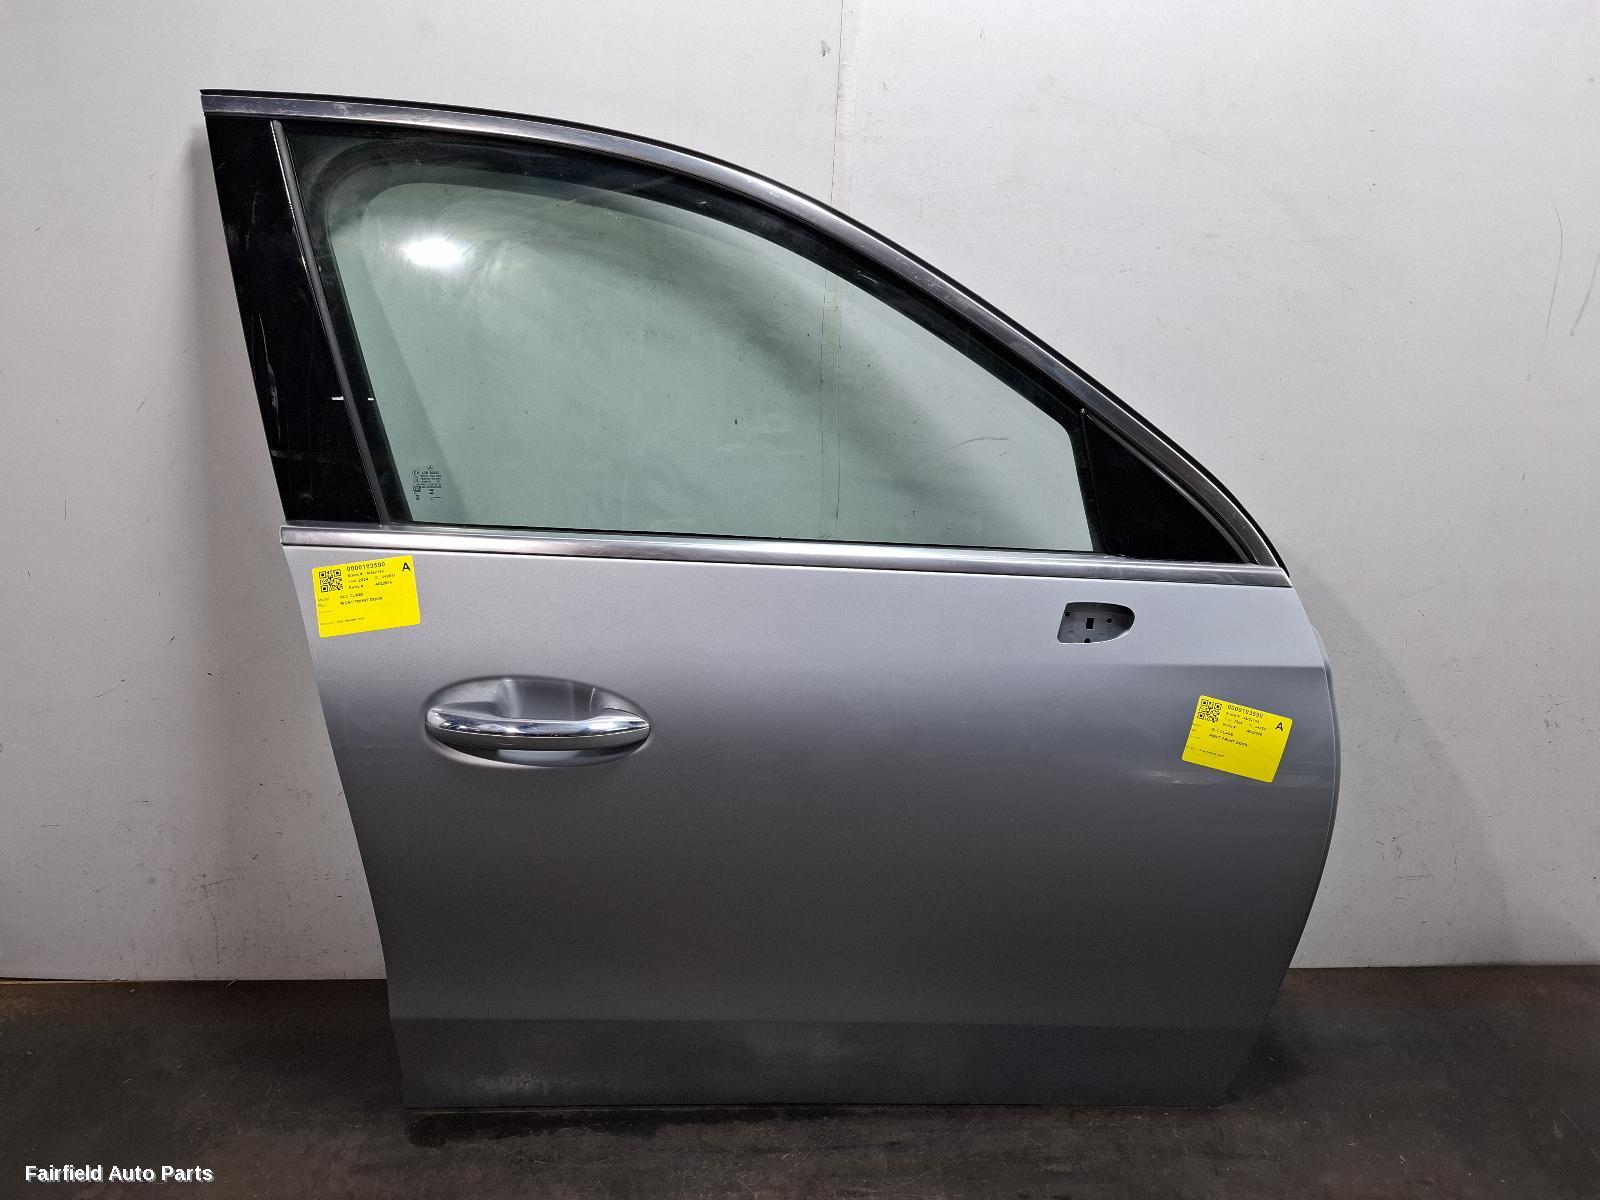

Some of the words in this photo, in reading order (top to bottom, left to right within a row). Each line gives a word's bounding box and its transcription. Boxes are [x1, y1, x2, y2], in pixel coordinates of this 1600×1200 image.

[347, 562, 386, 572] 0000103590
[402, 562, 411, 572] A
[1227, 704, 1264, 719] 0000103590
[1275, 721, 1284, 732] A
